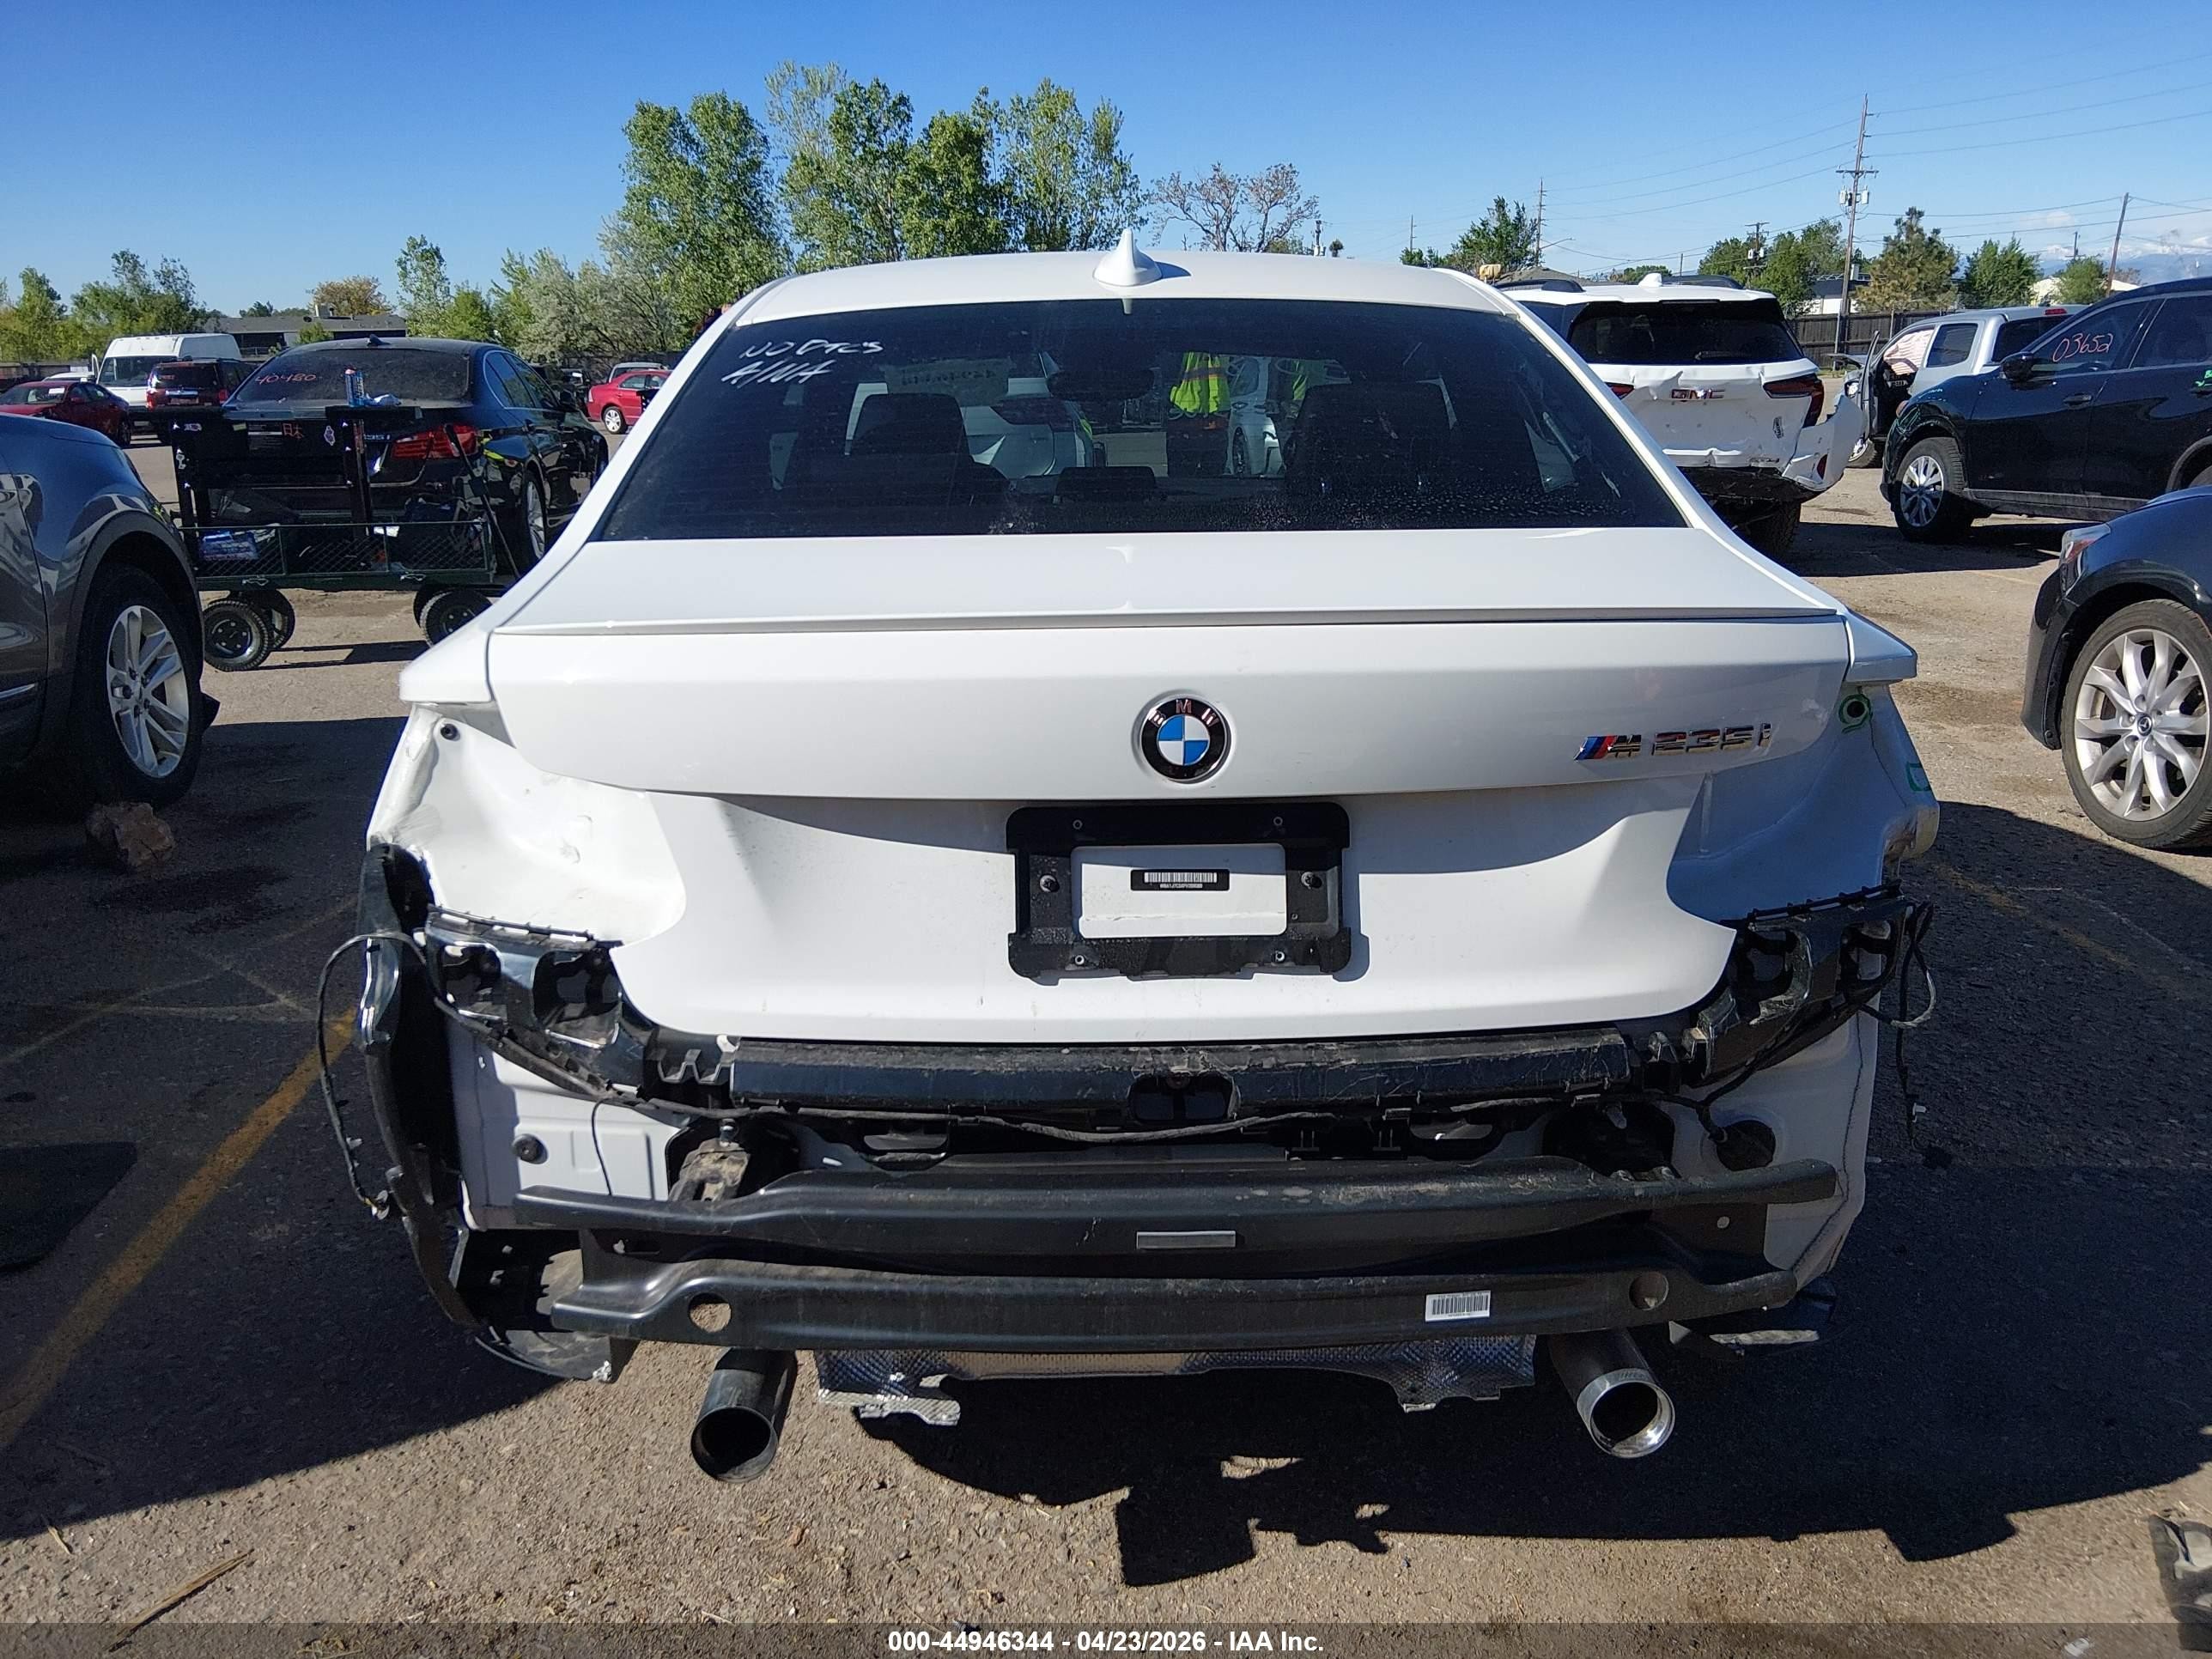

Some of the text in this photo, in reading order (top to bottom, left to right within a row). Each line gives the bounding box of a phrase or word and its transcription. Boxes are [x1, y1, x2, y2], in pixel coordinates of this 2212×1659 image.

[739, 342, 796, 358] NO
[2052, 333, 2113, 362] 03652
[255, 373, 317, 385] 40480
[1671, 389, 1725, 399] GMC
[1147, 698, 1220, 728] BMW
